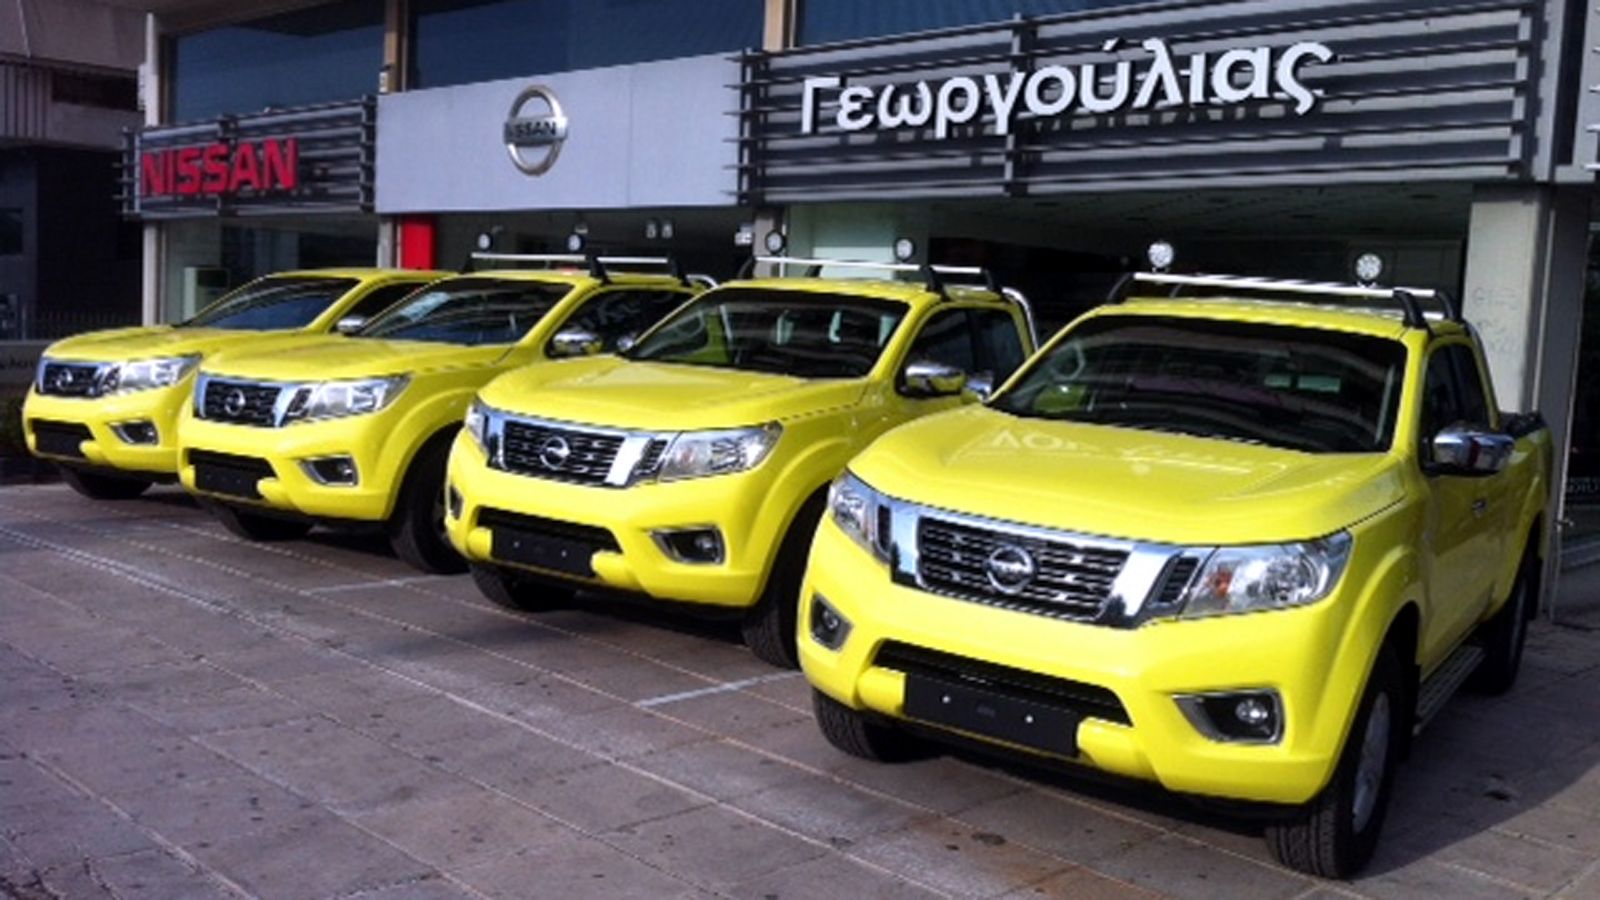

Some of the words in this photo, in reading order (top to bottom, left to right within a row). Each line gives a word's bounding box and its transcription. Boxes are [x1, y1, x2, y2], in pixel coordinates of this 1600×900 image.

[801, 37, 1333, 139] Γεωργούλιας
[506, 119, 557, 138] SSAN
[141, 136, 299, 197] NISSAN
